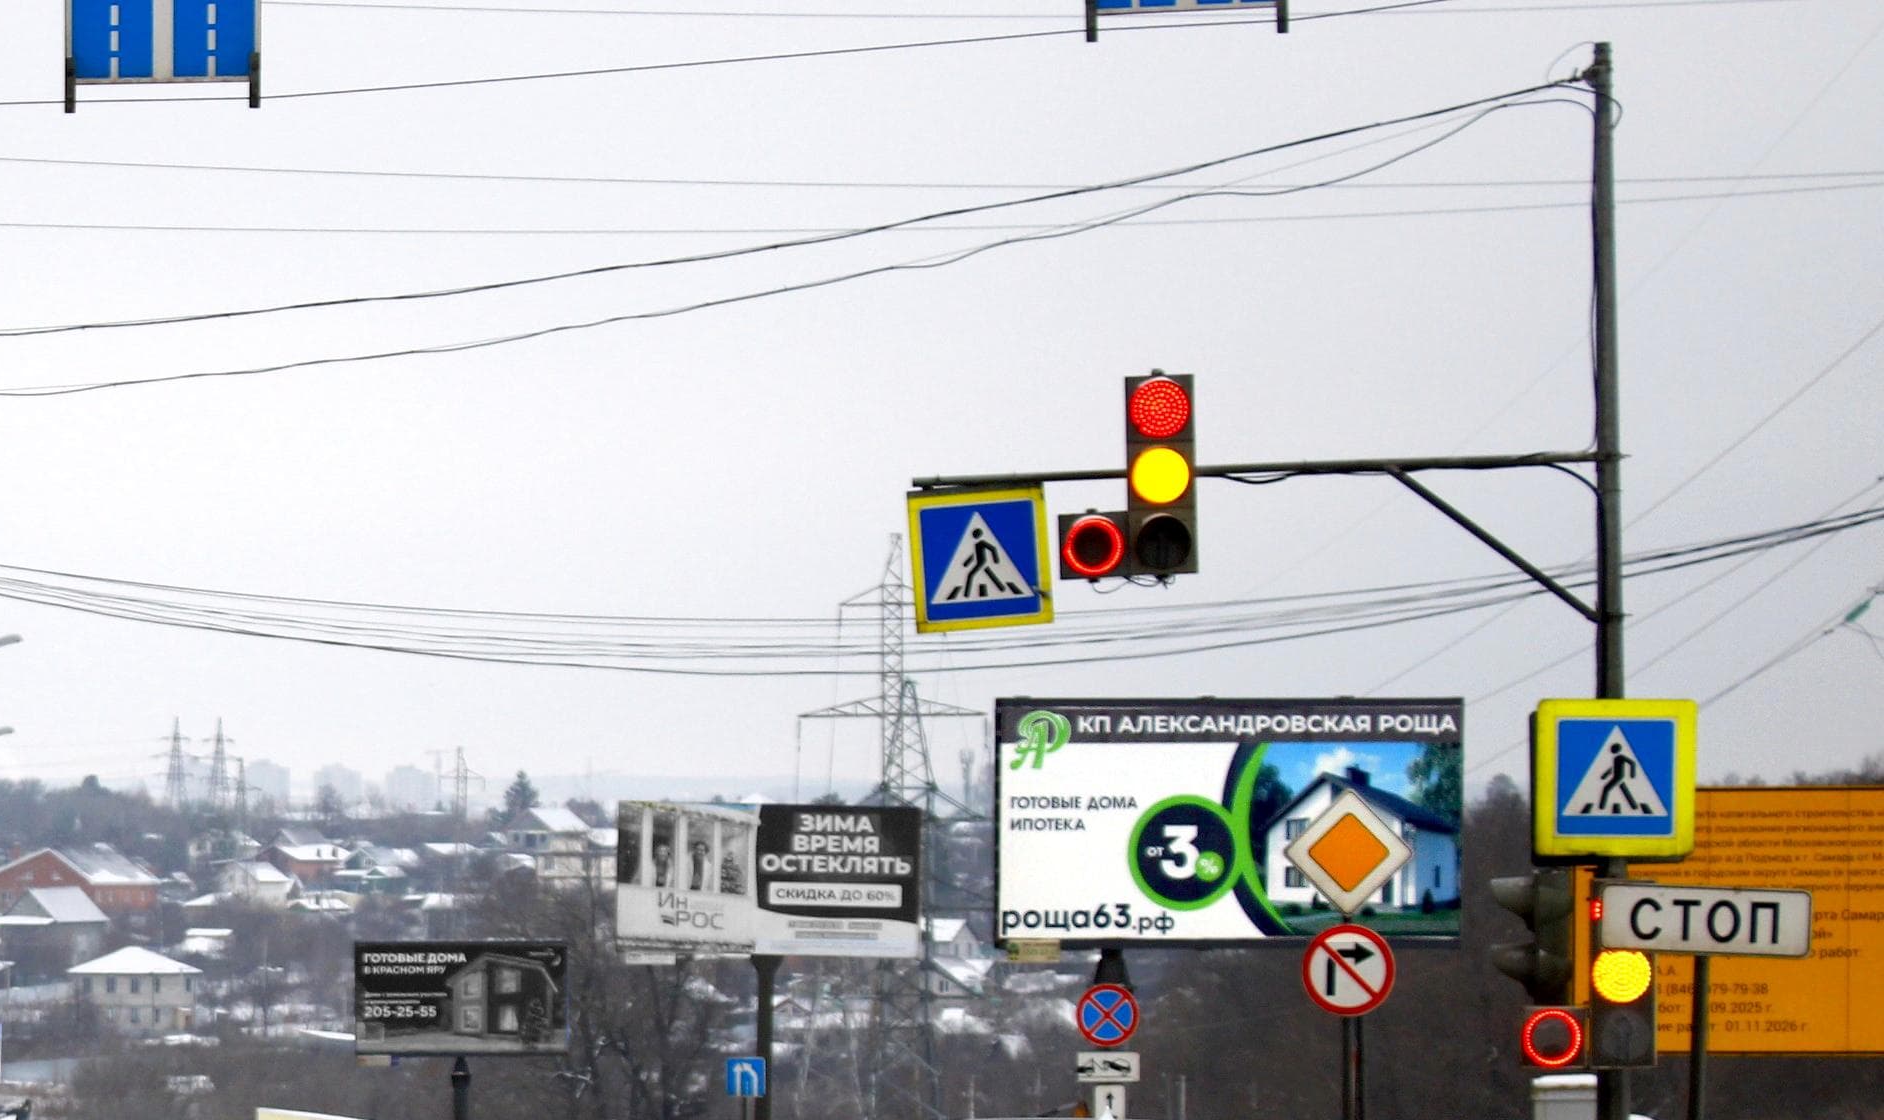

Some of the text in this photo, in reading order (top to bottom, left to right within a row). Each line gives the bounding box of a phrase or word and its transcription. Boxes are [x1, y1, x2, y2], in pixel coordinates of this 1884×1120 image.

[1077, 714, 1458, 736] КП АЛЕКСАНДРОВСКАЯ РОЩА
[1011, 796, 1138, 811] ГОТОВЫЕ ДОМА
[799, 814, 874, 832] ЗИМА
[1011, 818, 1086, 831] ИПОТЕКА
[792, 834, 880, 853] ВРЕМЯ
[1146, 846, 1165, 857] от
[761, 853, 911, 875] ОСТЕКЛЯТЬ
[776, 888, 836, 900] СКИДКА
[840, 889, 863, 901] ДО
[1002, 904, 1175, 934] роща63.рф
[1630, 897, 1780, 944] СТОП
[363, 953, 467, 964] ГОТОВЫЕ ДОМА
[364, 1006, 437, 1018] 205-25-55
